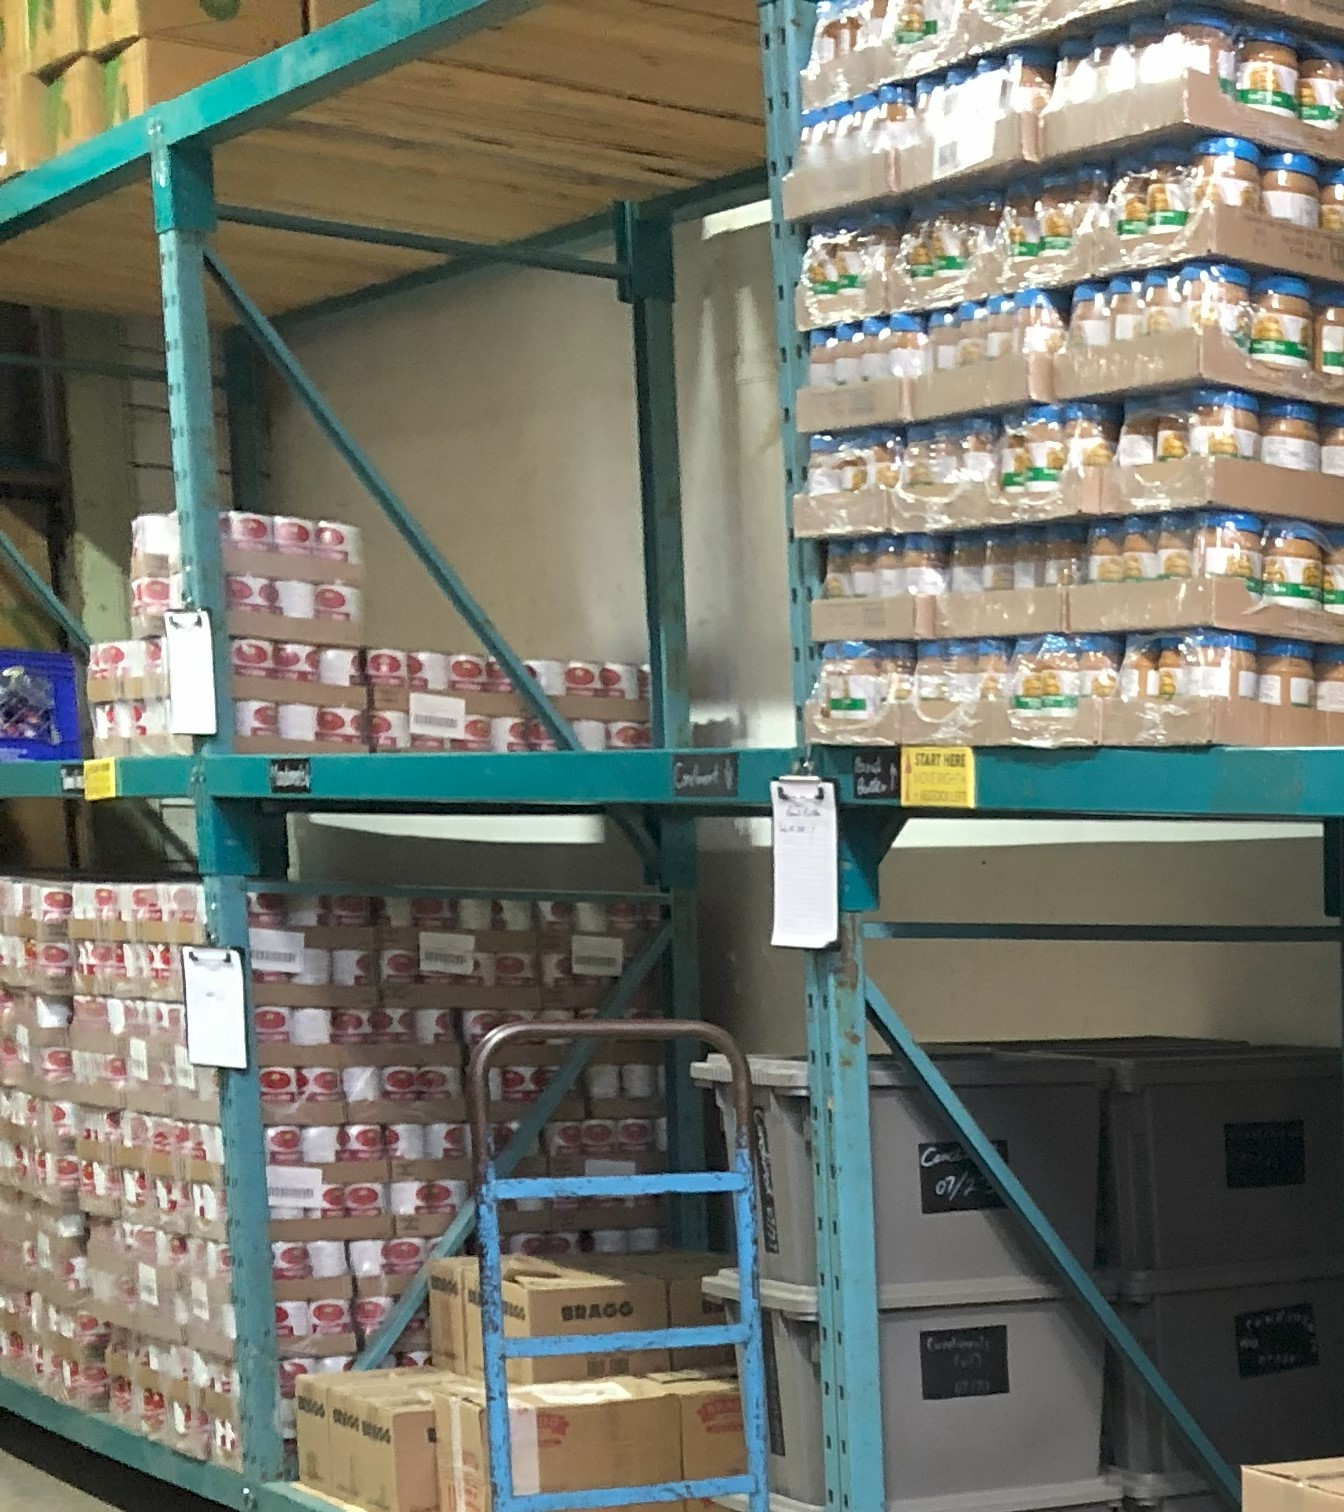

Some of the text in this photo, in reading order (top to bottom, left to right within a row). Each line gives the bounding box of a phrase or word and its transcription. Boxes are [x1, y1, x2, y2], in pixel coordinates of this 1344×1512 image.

[914, 753, 966, 767] START HERE
[561, 1301, 634, 1322] BRAGG
